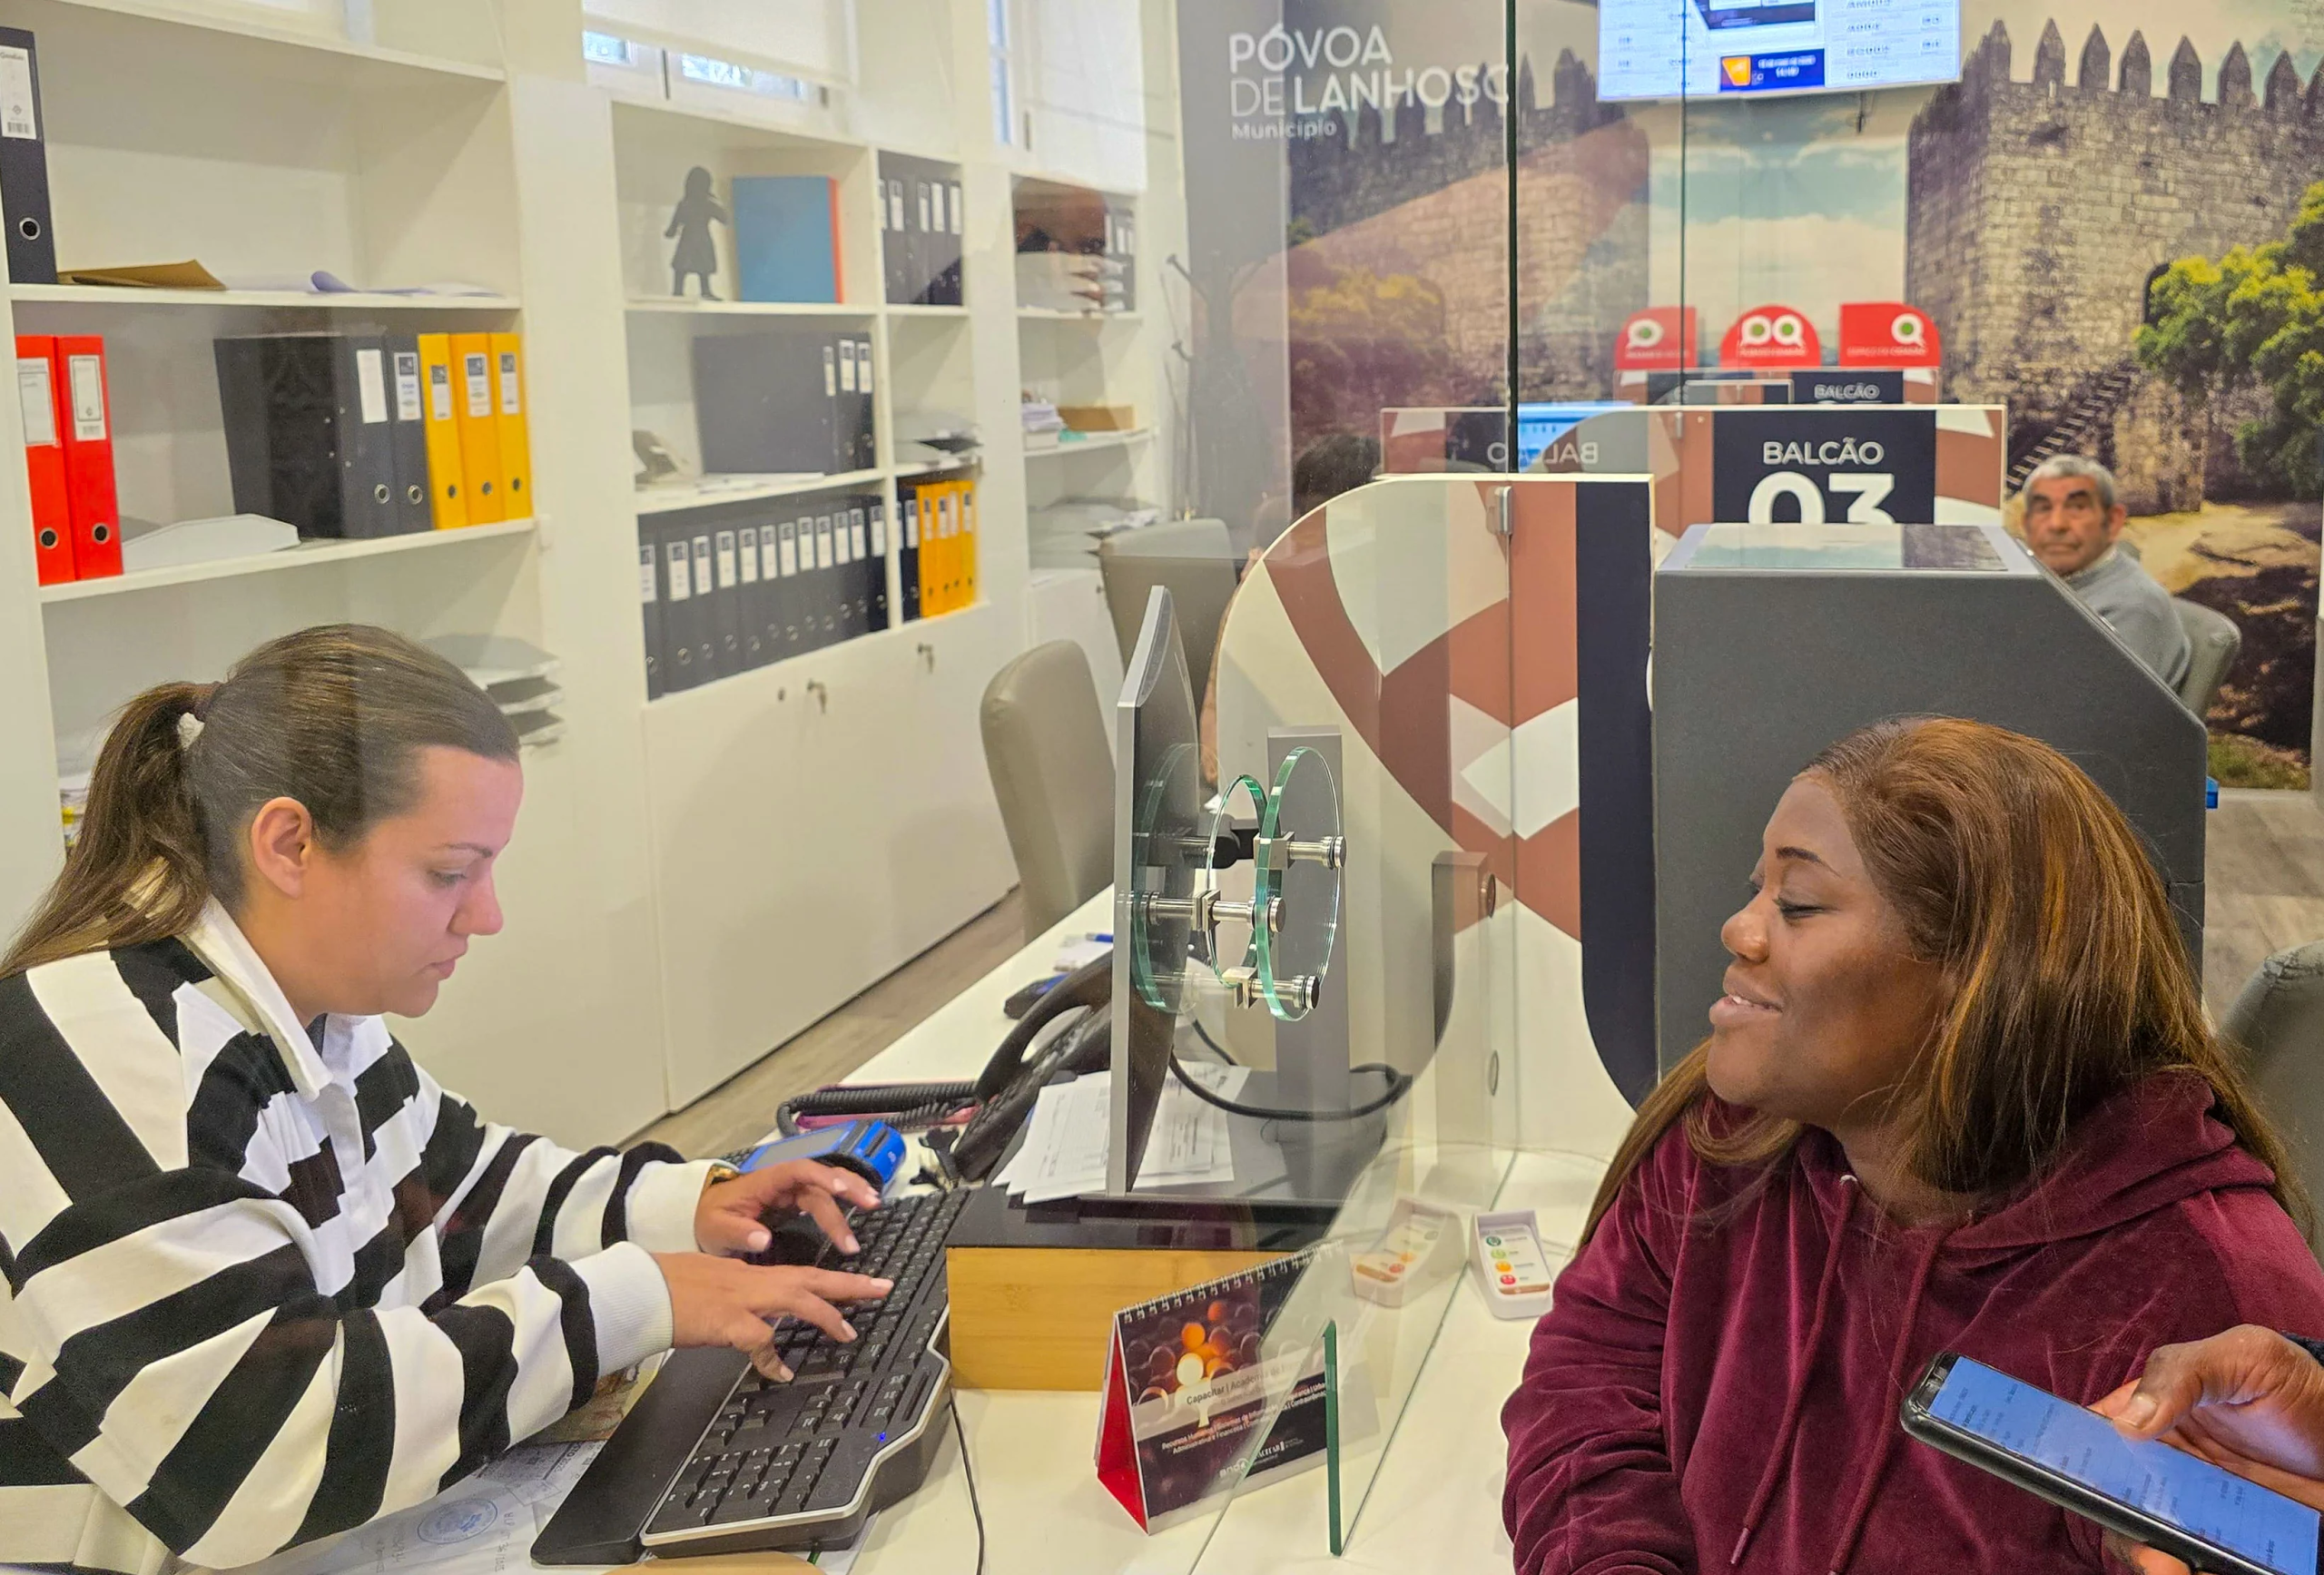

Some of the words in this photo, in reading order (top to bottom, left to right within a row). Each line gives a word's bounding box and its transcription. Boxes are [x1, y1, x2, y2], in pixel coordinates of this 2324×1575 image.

[1229, 22, 1393, 74] PÓVOA
[1230, 74, 1285, 117] DE
[1814, 381, 1880, 399] BALCÃO
[1763, 437, 1885, 465] BALCÃO
[1748, 471, 1896, 524] 03
[1187, 1385, 1225, 1405] Capacitar
